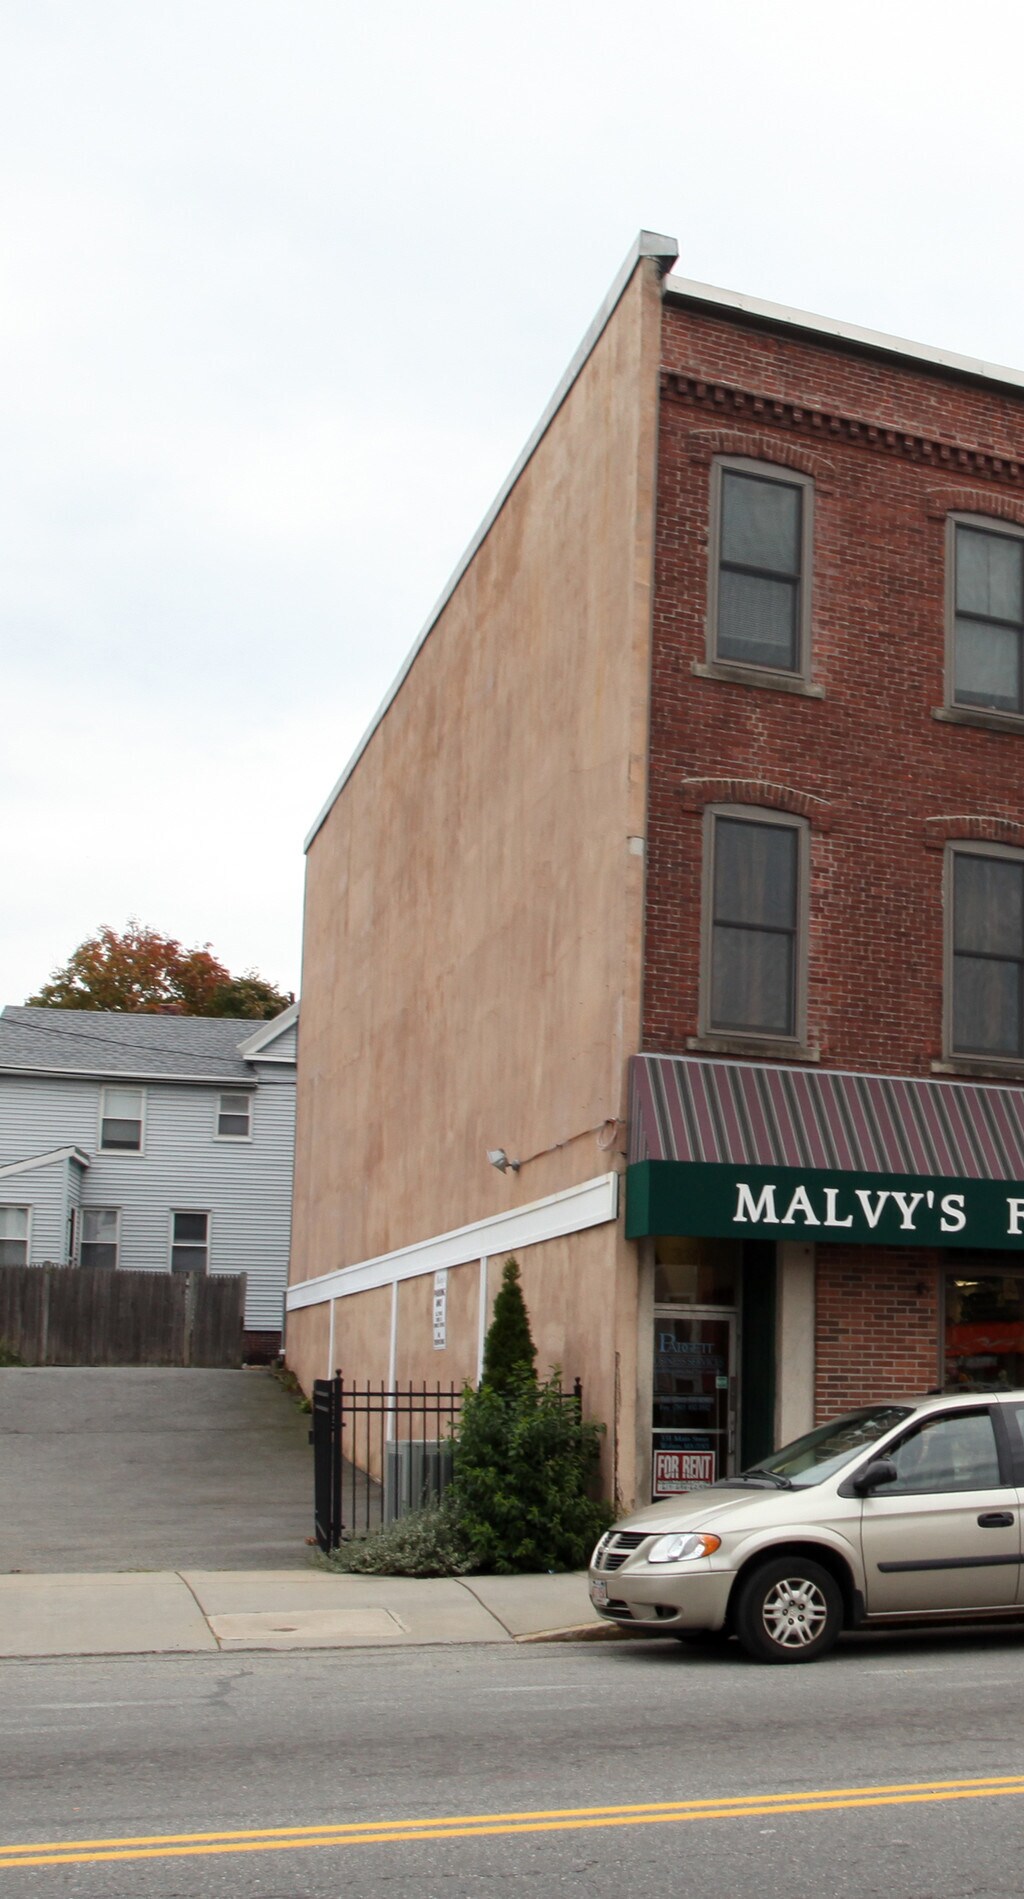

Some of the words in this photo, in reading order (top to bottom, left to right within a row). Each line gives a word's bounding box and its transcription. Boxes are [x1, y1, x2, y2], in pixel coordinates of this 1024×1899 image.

[733, 1183, 967, 1232] MALVY'S
[657, 1455, 679, 1479] FOR
[682, 1455, 711, 1479] RENT
